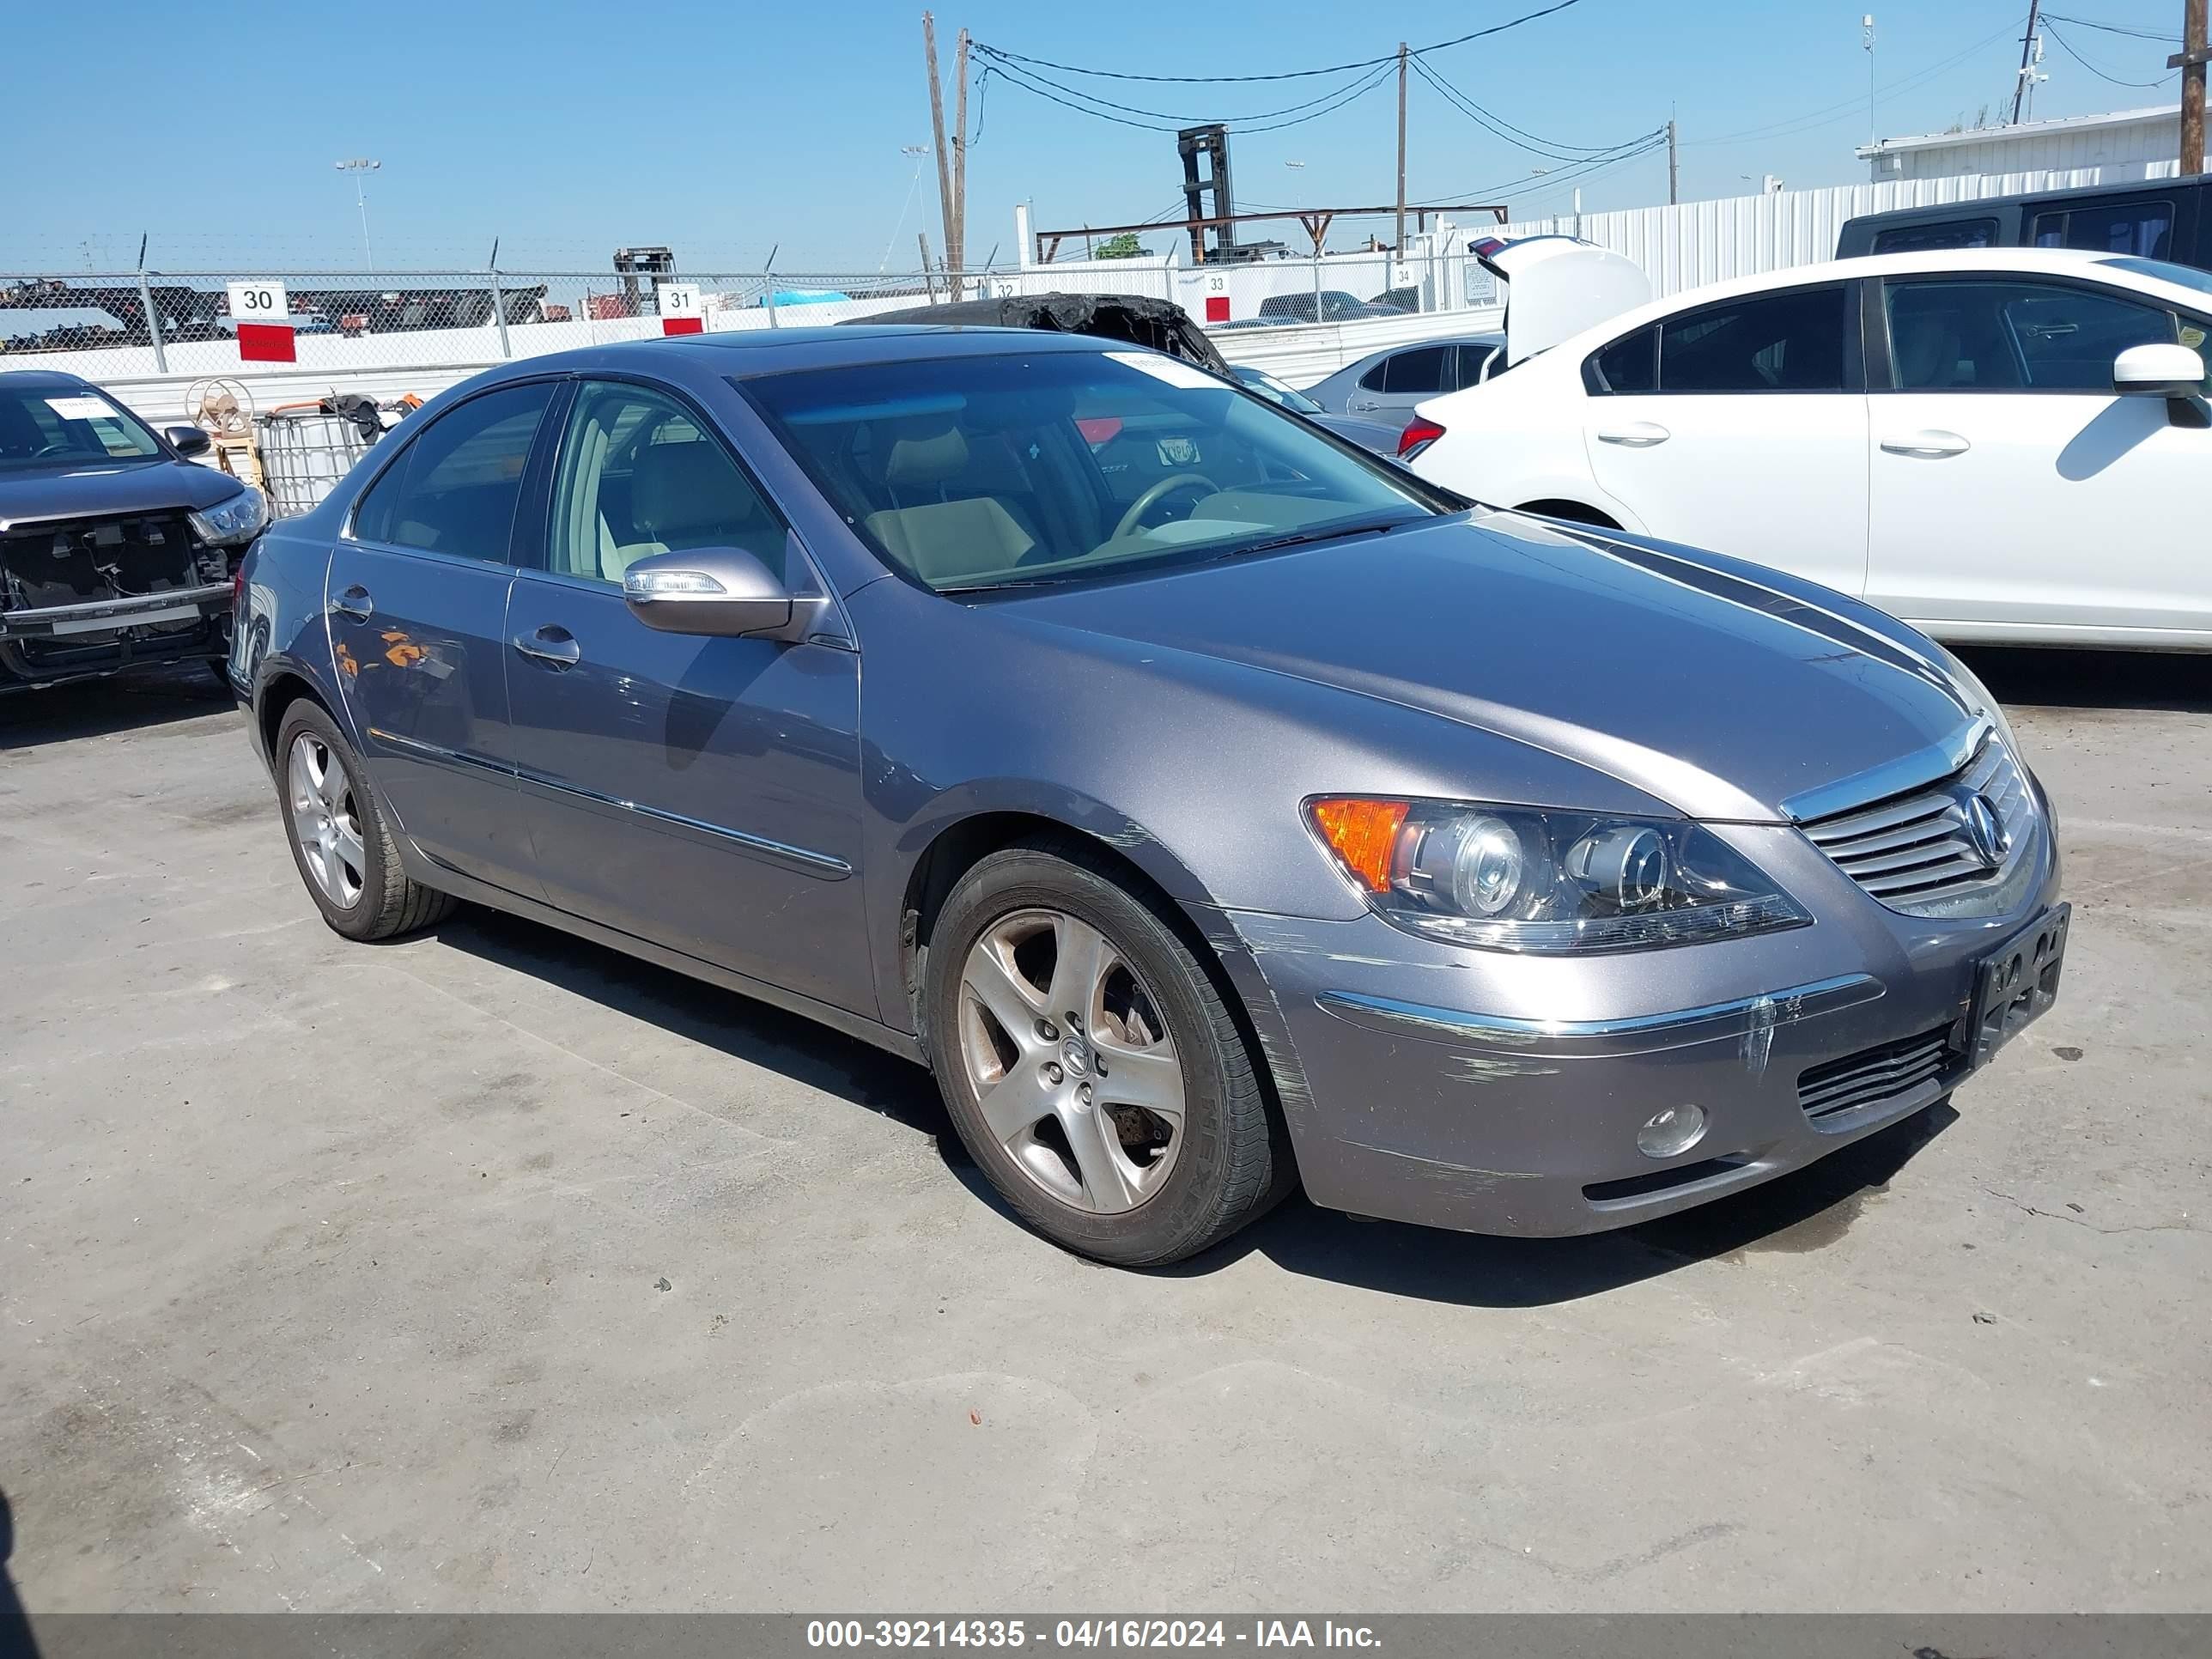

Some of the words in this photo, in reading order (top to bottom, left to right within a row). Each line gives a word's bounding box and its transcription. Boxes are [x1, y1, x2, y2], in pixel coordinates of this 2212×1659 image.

[1211, 277, 1224, 290] 33
[1399, 270, 1409, 283] 34
[998, 284, 1013, 299] 32
[244, 290, 273, 310] 30
[671, 292, 690, 308] 31
